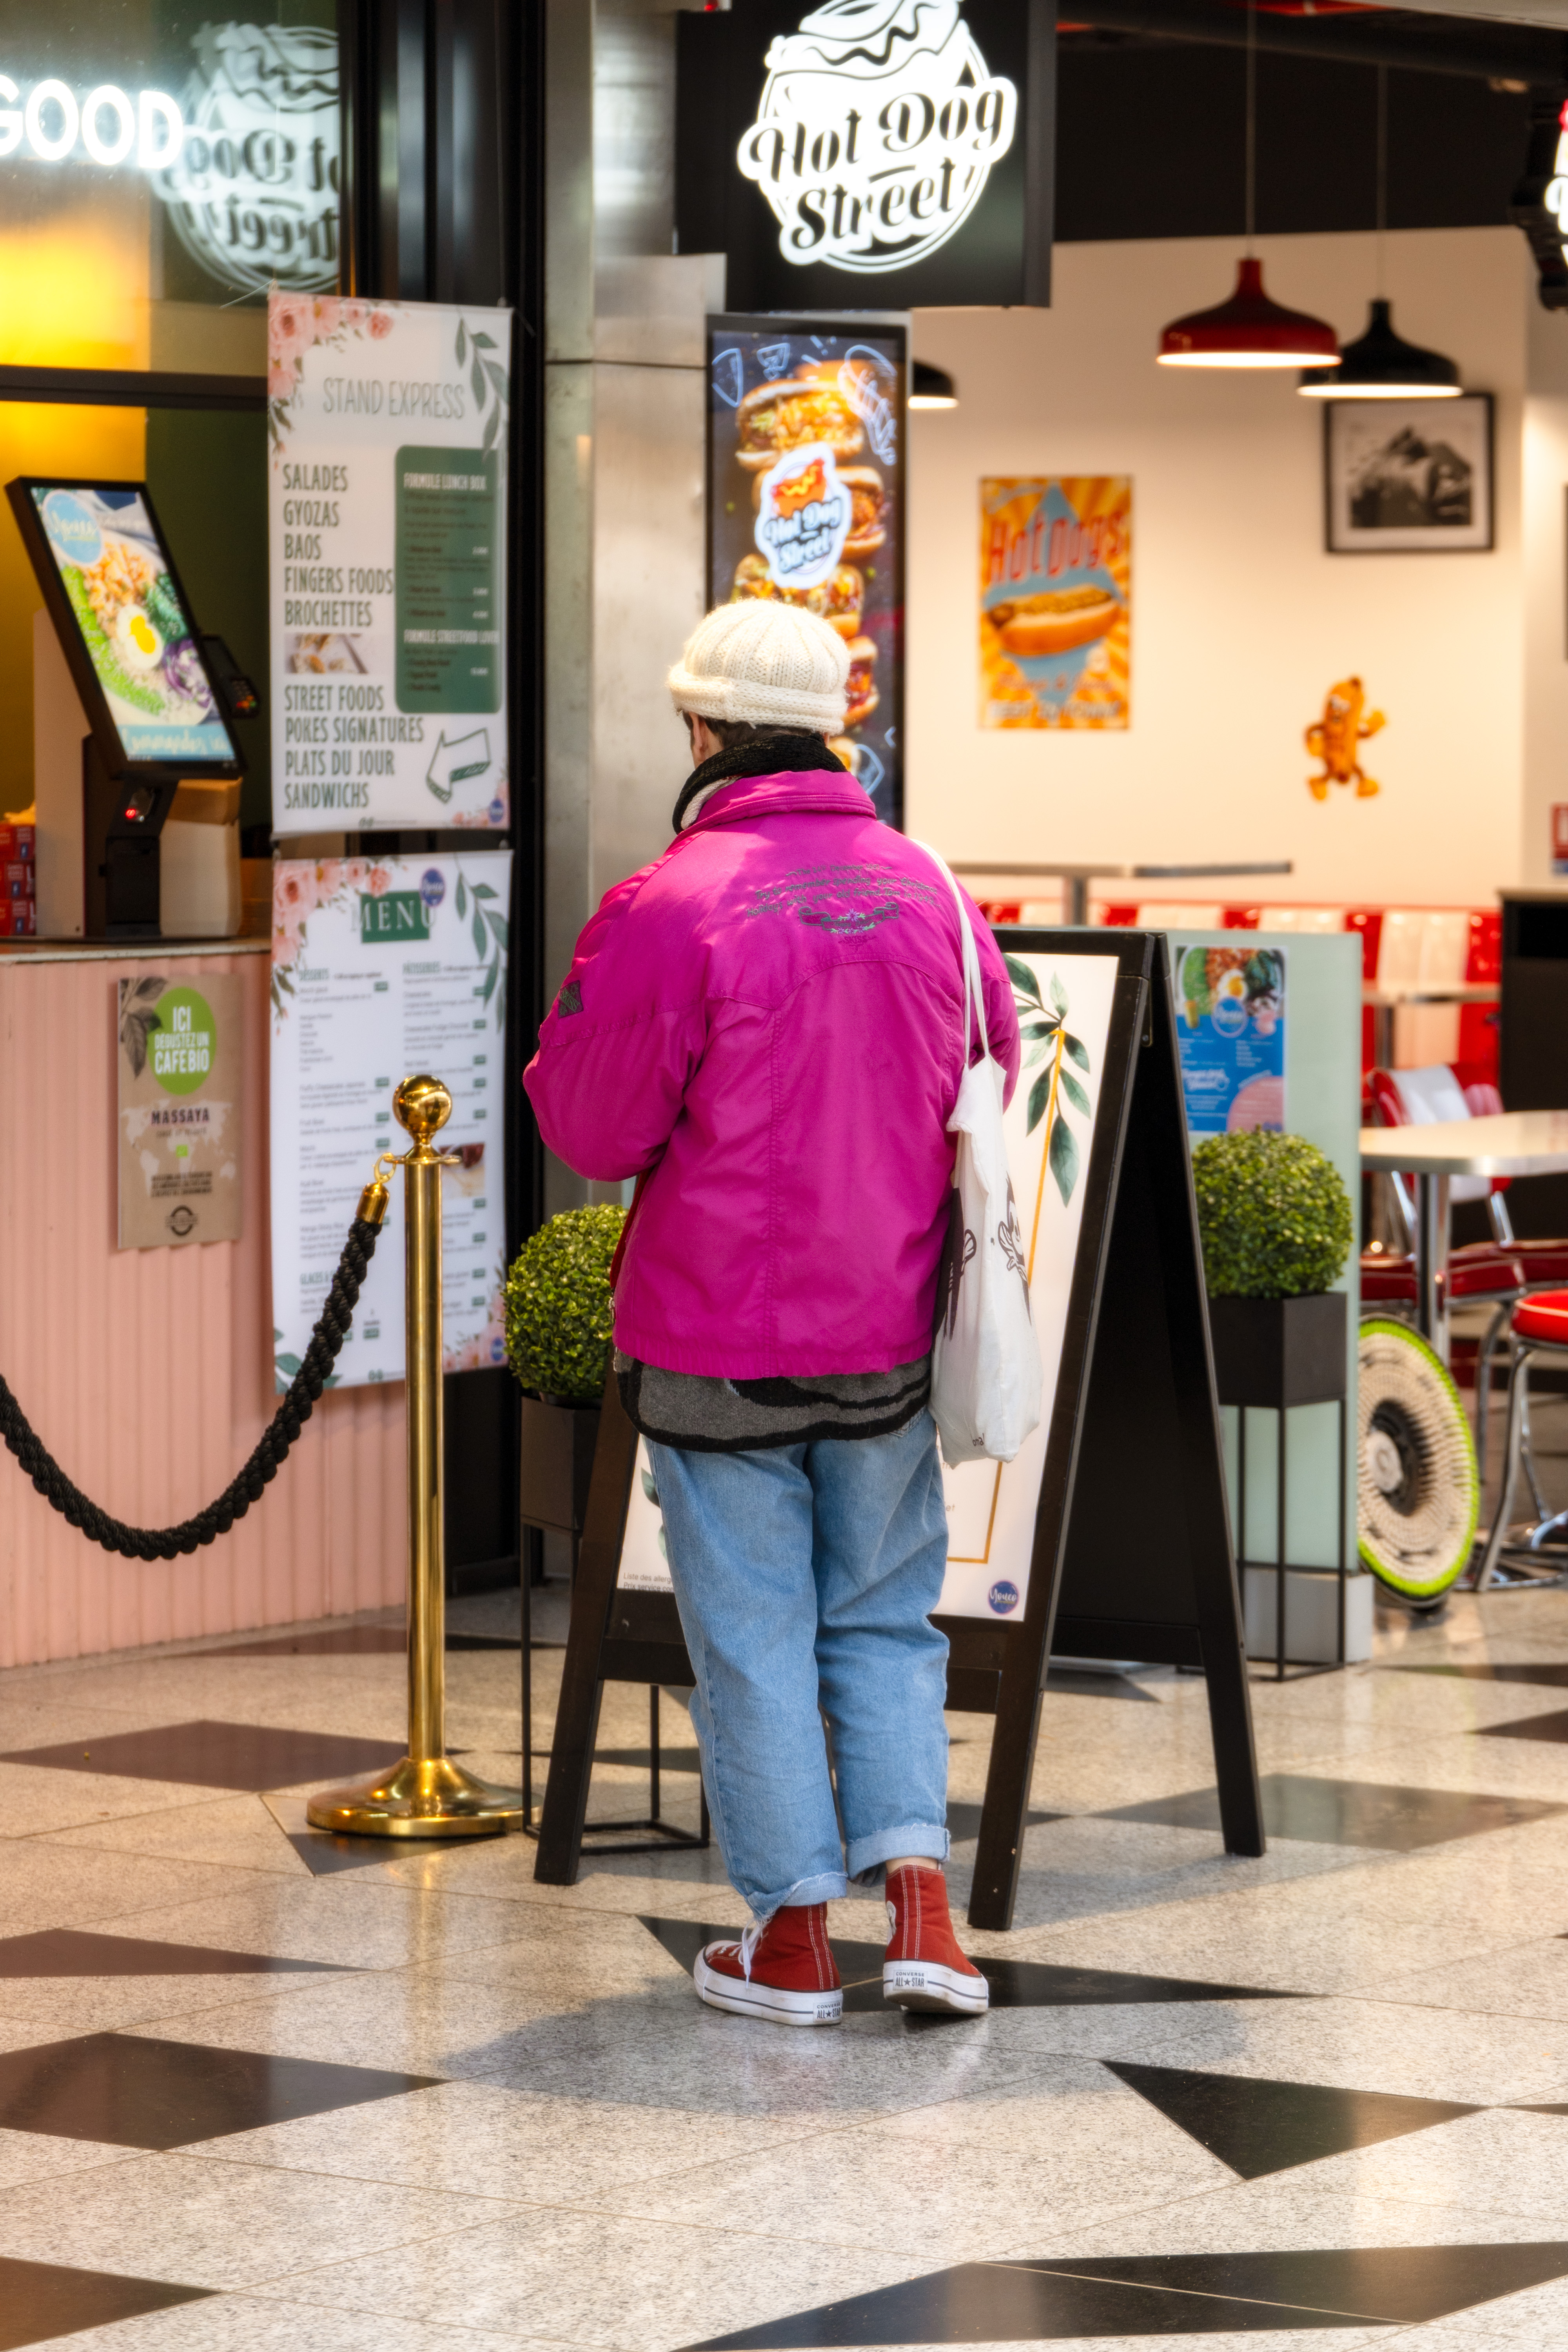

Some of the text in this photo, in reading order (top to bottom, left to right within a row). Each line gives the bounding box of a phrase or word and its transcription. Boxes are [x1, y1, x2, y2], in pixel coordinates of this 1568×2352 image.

[749, 89, 1004, 183] Hot Dog
[791, 158, 956, 249] Street
[323, 377, 465, 419] STAND EXPRESS
[283, 464, 348, 492] SALADES
[284, 500, 340, 526] GYOZAS
[284, 534, 321, 560] BAOS
[284, 566, 343, 593] FINGERS
[349, 568, 393, 593] FOODS
[285, 600, 372, 626] BROCHETTES
[285, 684, 384, 710] STREET FOODS
[285, 717, 424, 742] POKES SIGNATURES
[285, 750, 395, 776] PLATS DU JOUR
[285, 782, 369, 809] SANDWICHS
[755, 889, 770, 900] Try
[773, 886, 782, 895] to
[785, 878, 831, 892] remember
[833, 875, 870, 886] spending
[746, 902, 783, 917] Holidays
[787, 895, 807, 906] with
[813, 893, 833, 904] your
[837, 889, 850, 898] old
[853, 887, 881, 897] friend
[883, 887, 900, 896] Tom
[350, 899, 437, 933] MENU
[173, 1005, 191, 1033] ICI
[188, 1048, 210, 1073] BIO
[151, 1108, 209, 1124] MASSAYA
[653, 1575, 671, 1584] allerg
[912, 1977, 924, 1987] STAR
[817, 2007, 841, 2018] ALL STAR
